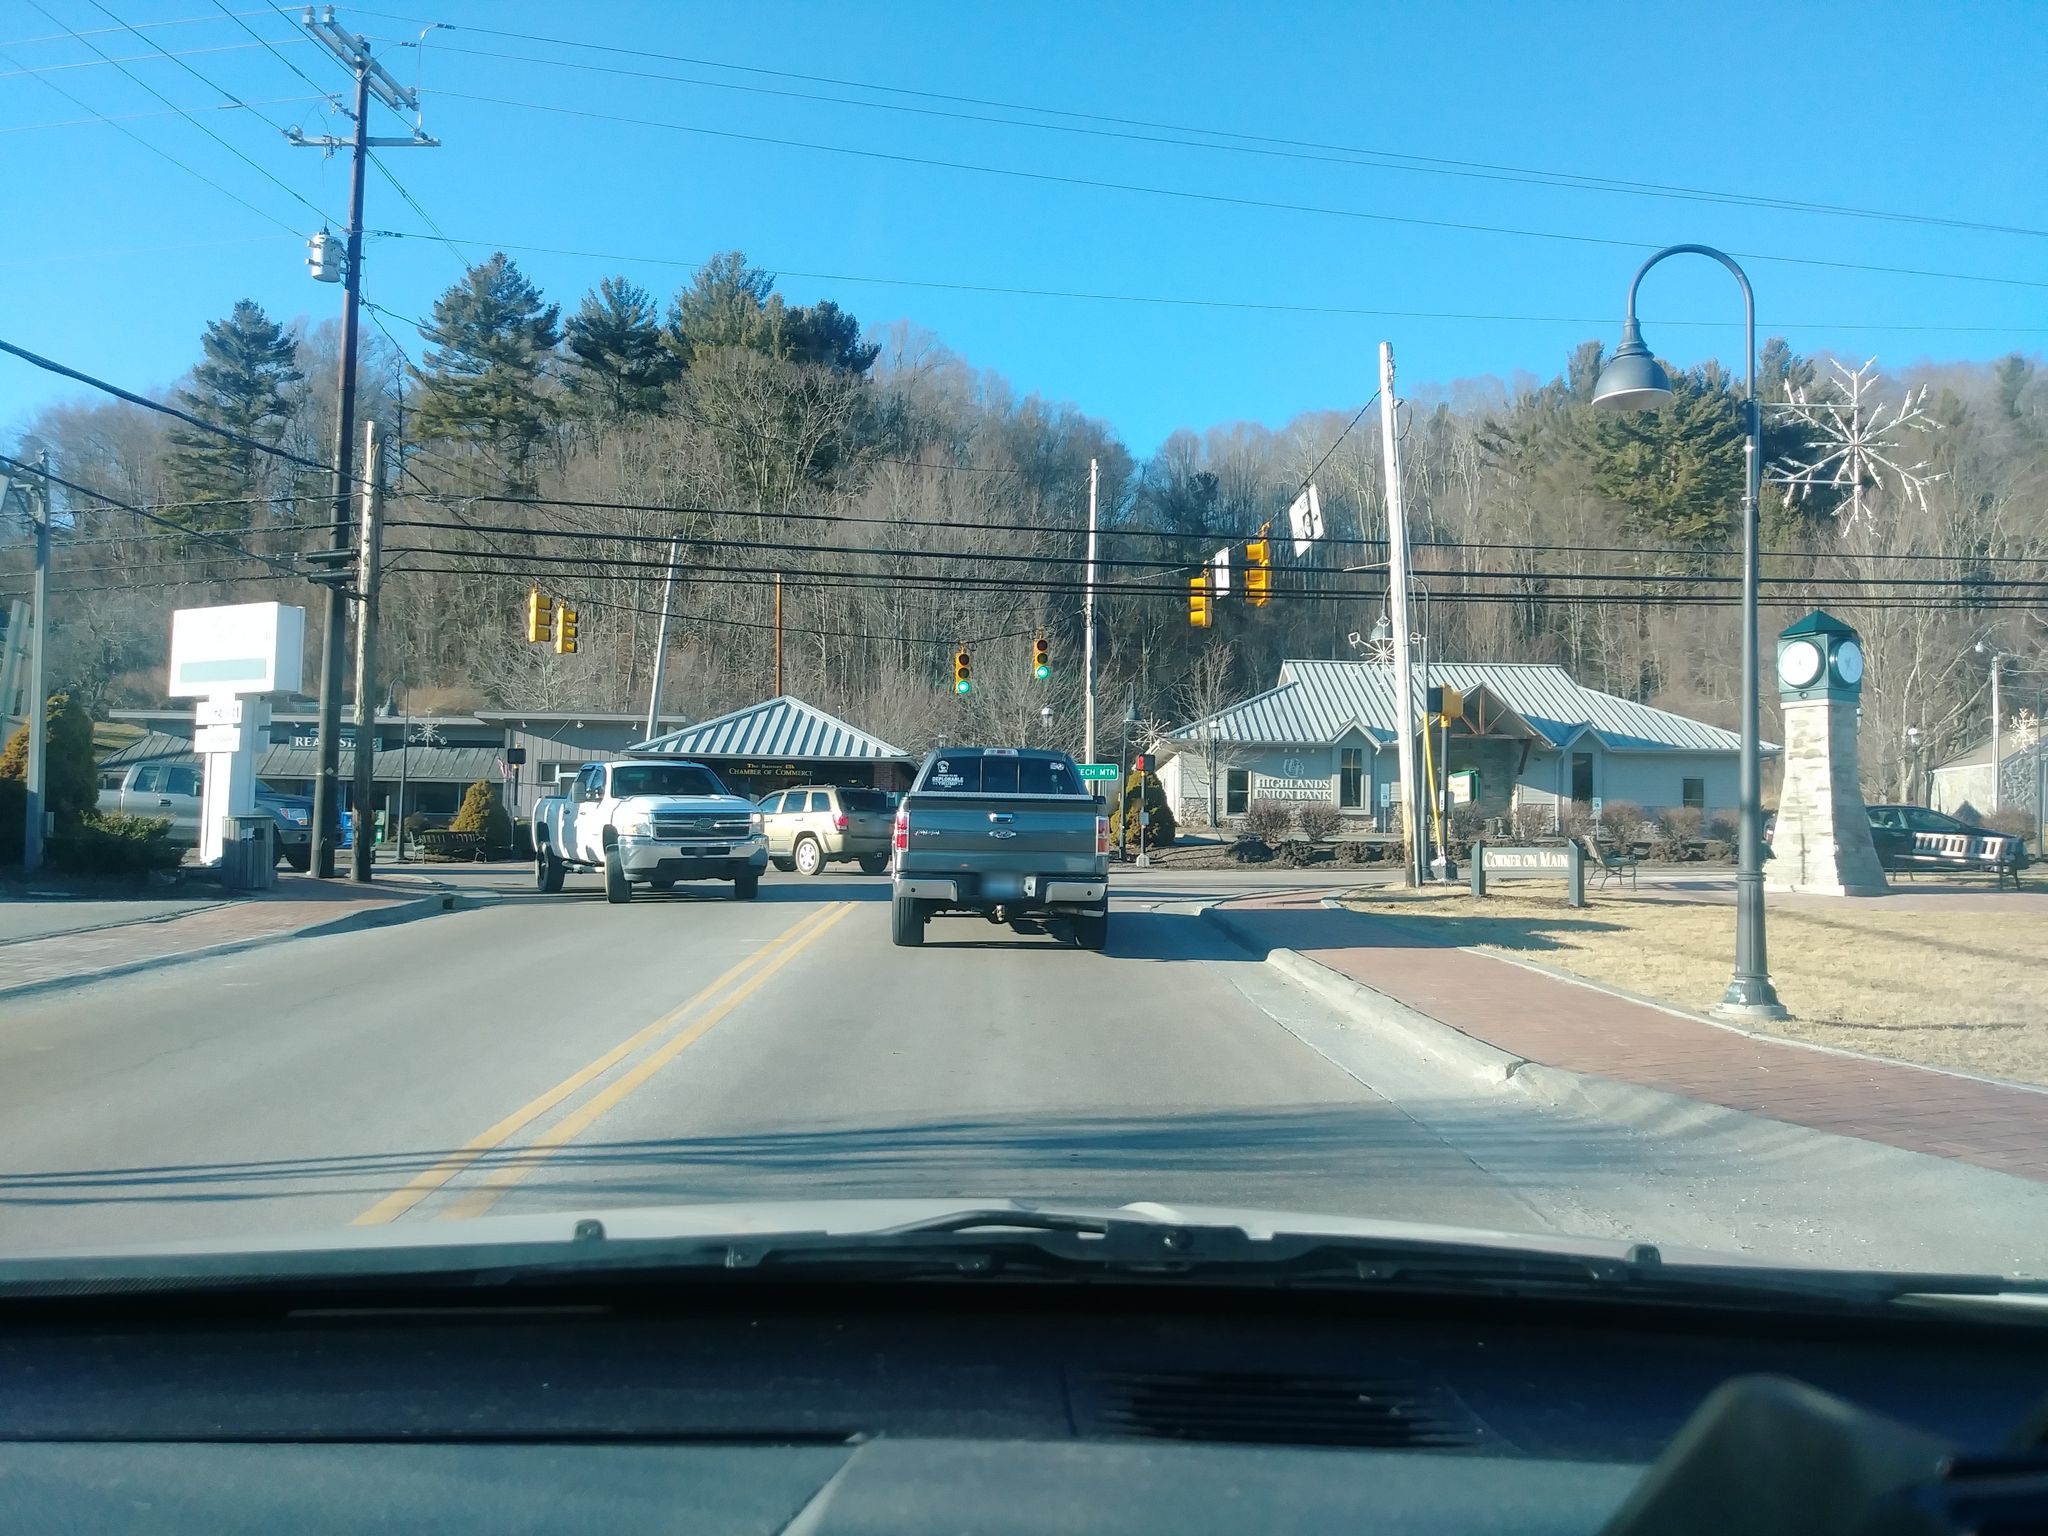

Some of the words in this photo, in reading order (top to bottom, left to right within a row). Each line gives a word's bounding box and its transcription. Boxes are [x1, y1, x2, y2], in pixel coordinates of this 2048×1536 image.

[295, 737, 320, 747] REA
[1078, 768, 1096, 776] ECH
[1256, 779, 1330, 789] HIGHLANDS
[1255, 788, 1293, 800] UNION
[1296, 790, 1332, 800] BANK
[1523, 854, 1538, 868] ON
[1540, 852, 1569, 868] MAIN
